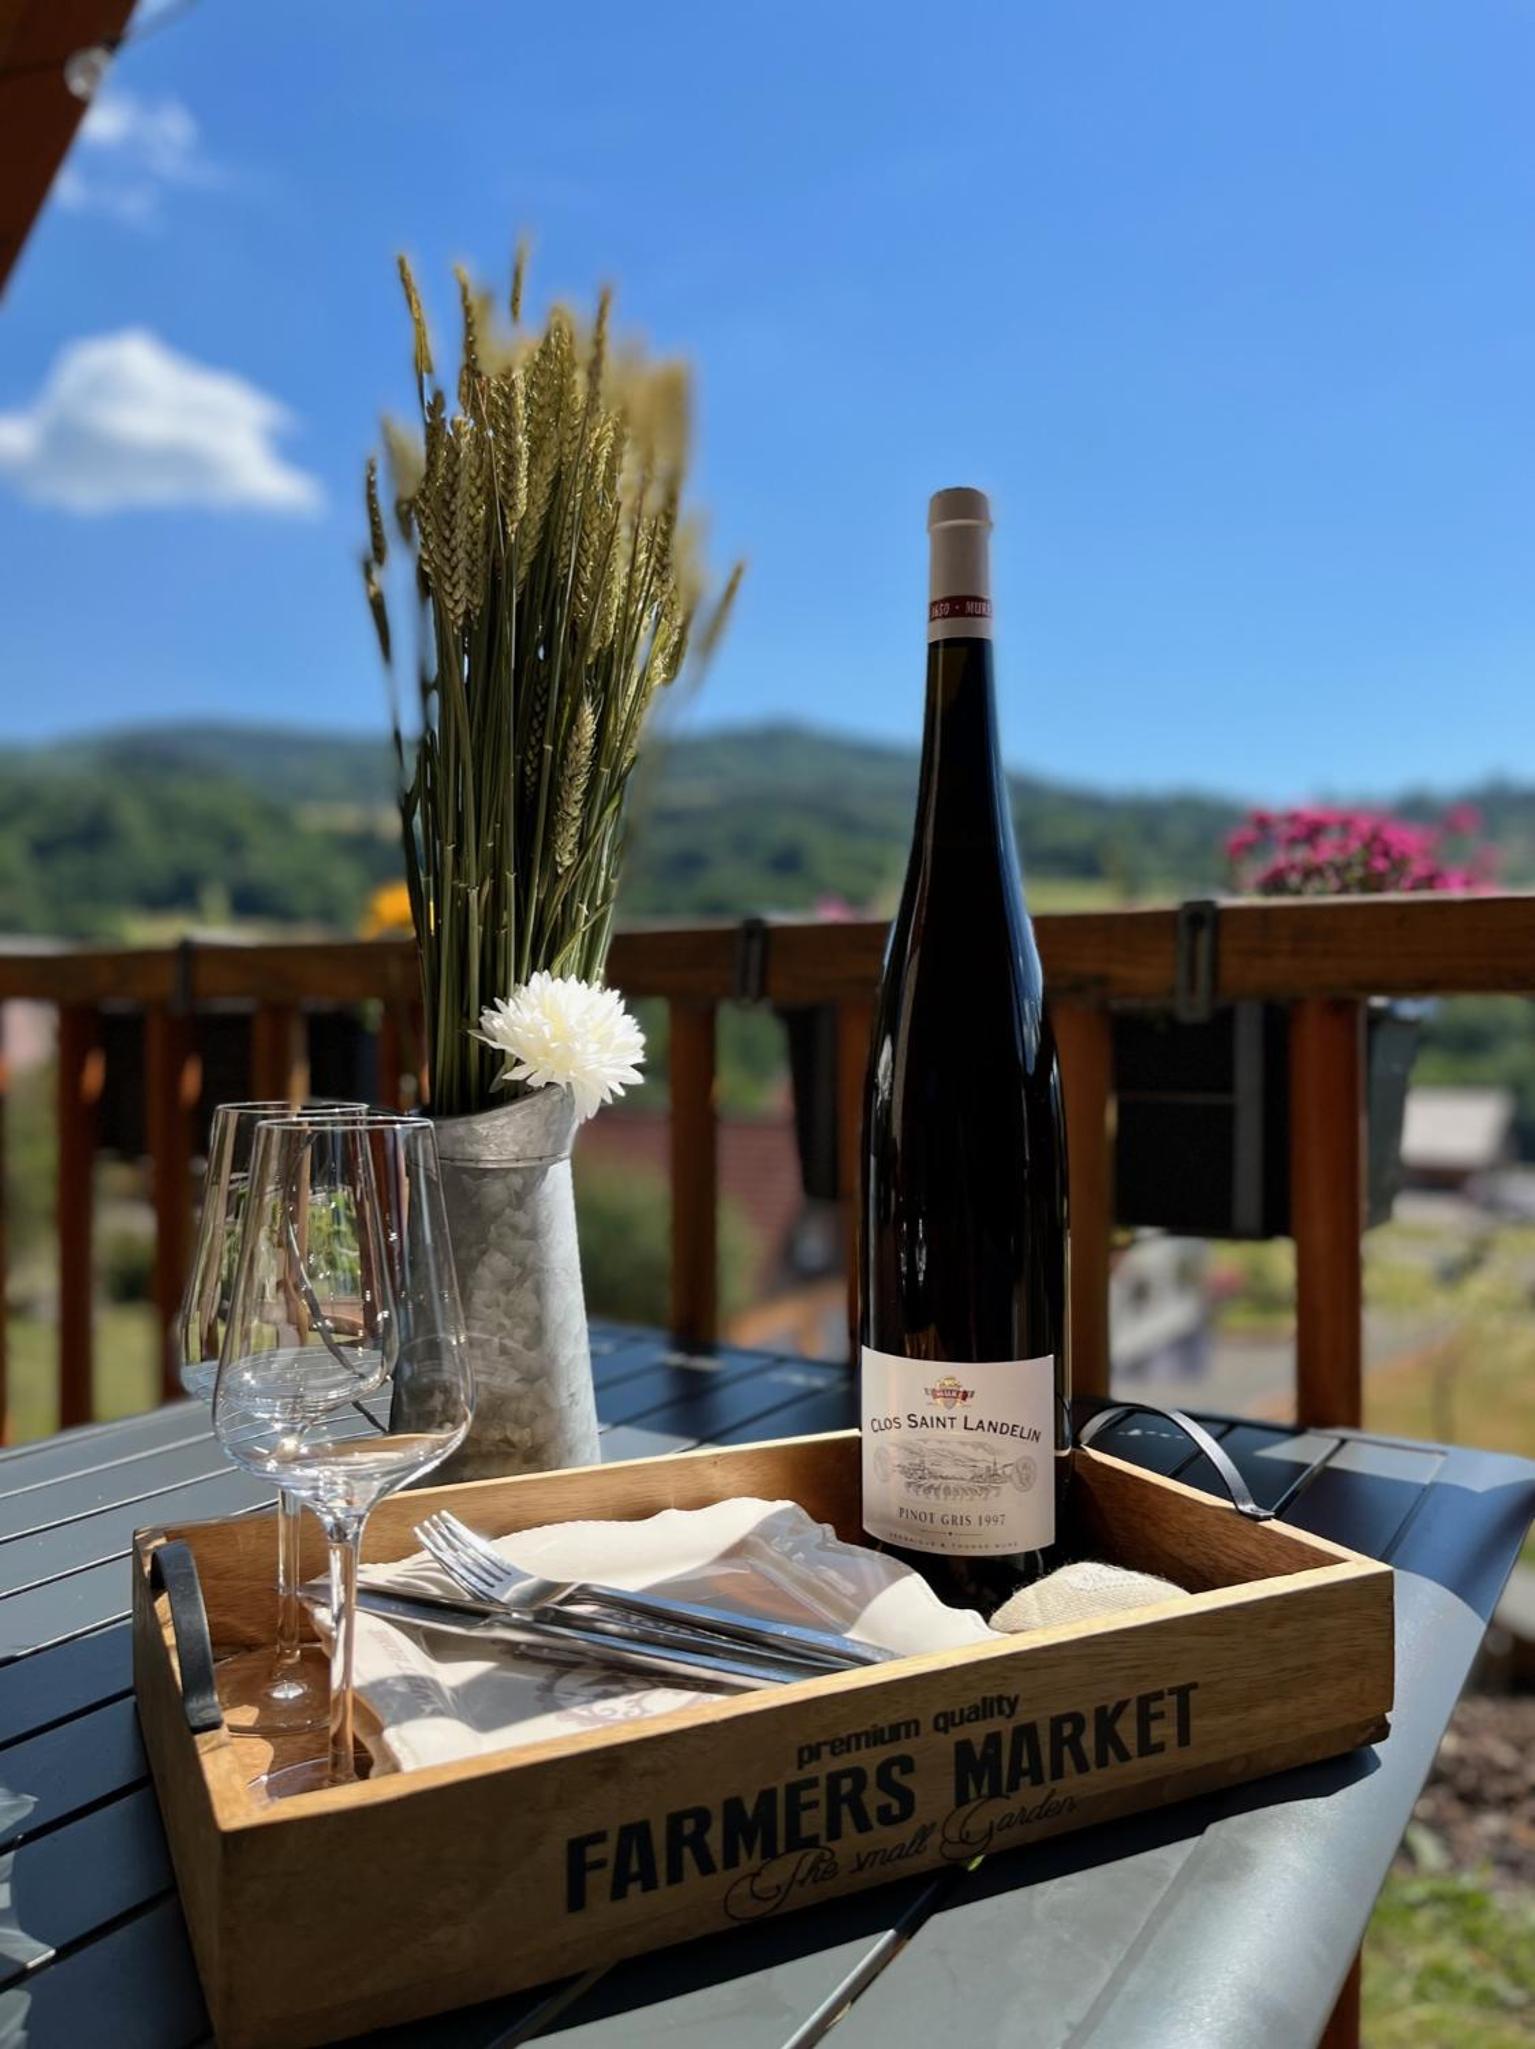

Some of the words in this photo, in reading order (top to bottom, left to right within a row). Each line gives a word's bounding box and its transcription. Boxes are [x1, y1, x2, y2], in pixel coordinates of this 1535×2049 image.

[870, 1417, 901, 1433] CLOS
[906, 1413, 957, 1430] SAINT
[963, 1414, 1042, 1443] LANDELIN
[898, 1507, 934, 1525] PINOT
[940, 1514, 972, 1526] GRIS
[978, 1514, 1006, 1527] 1997
[796, 1717, 920, 1769] premium
[933, 1693, 1020, 1735] quality
[565, 1752, 916, 1914] FARMERS
[953, 1681, 1200, 1809] MARKET
[723, 1845, 840, 1921] The
[848, 1821, 938, 1876] small
[938, 1792, 1080, 1862] Garden
